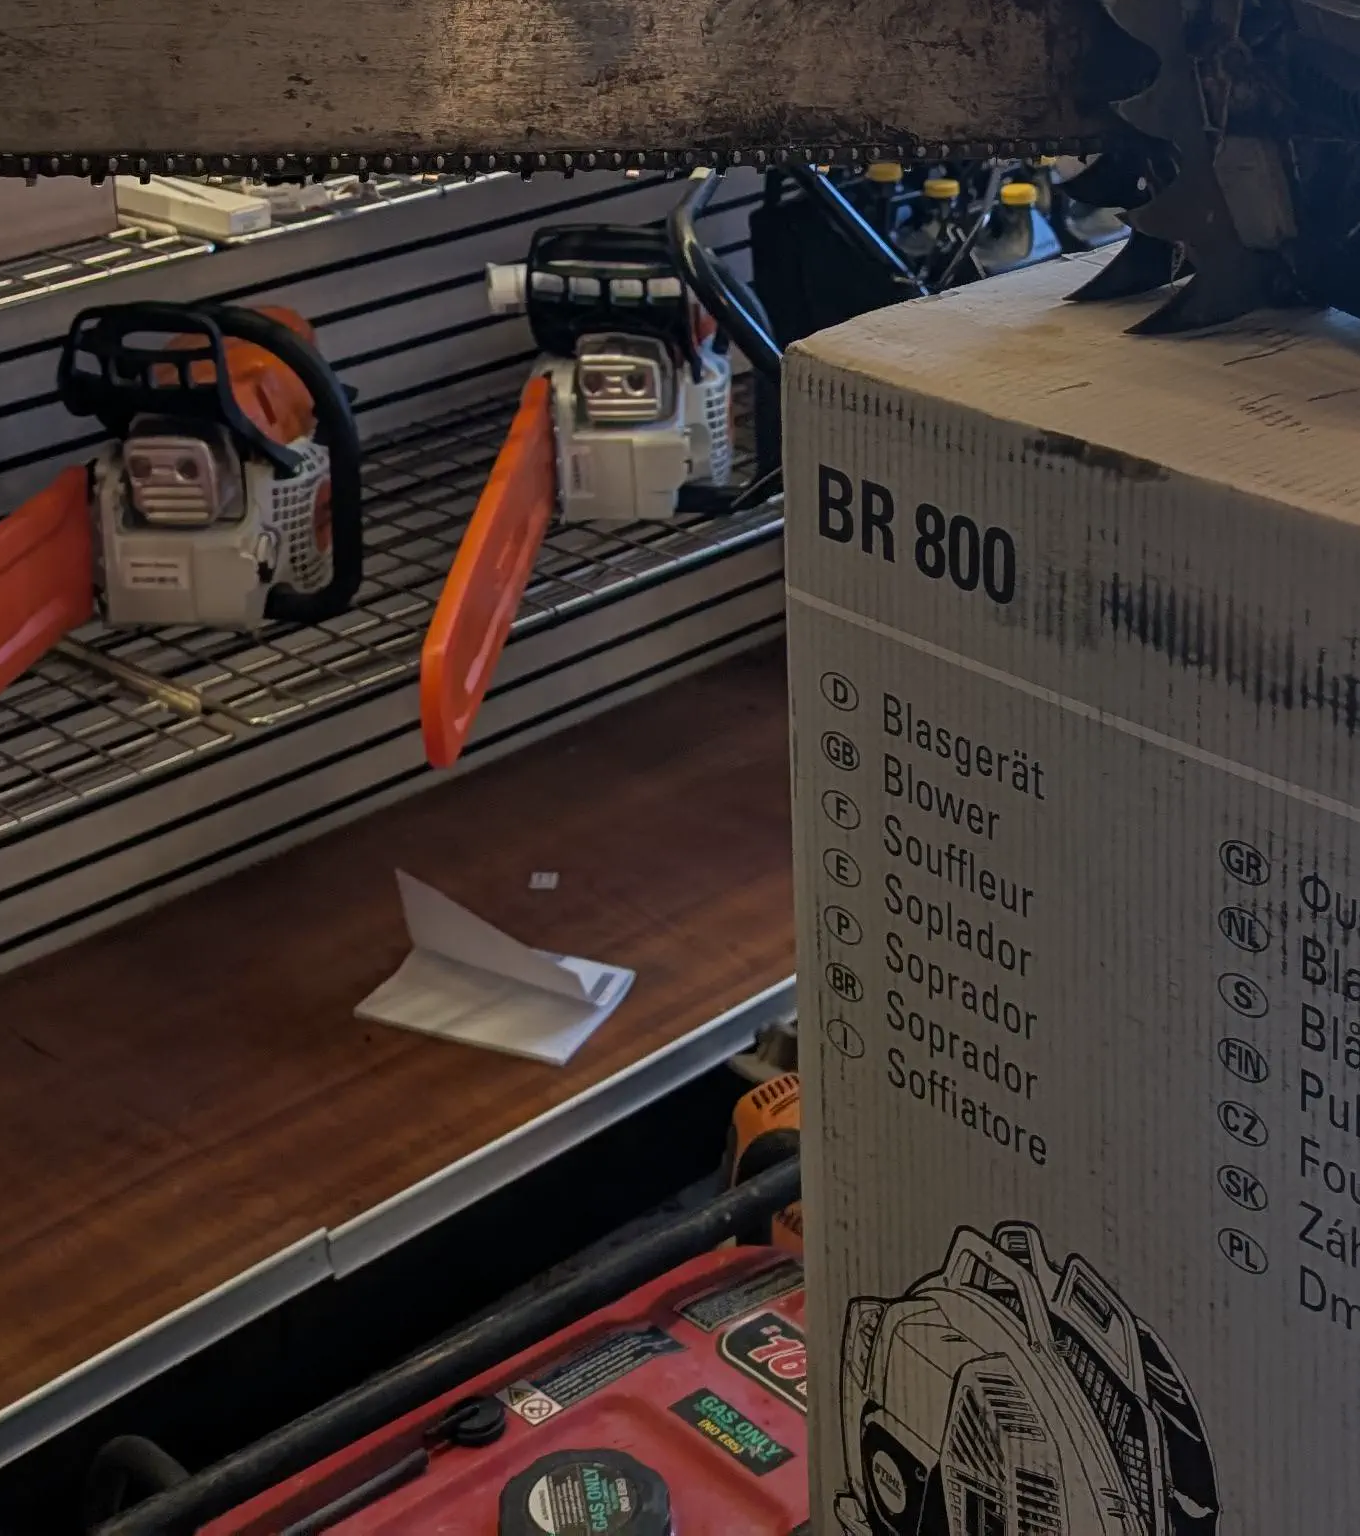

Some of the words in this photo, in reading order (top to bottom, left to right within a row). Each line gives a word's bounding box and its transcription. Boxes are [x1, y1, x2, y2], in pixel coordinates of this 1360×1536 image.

[818, 463, 896, 565] BR
[914, 502, 1017, 605] 800
[883, 692, 1046, 801] Blasgerät
[826, 735, 856, 766] GB
[883, 753, 1000, 841] Blower
[883, 814, 1034, 918] Souffleur
[1225, 845, 1262, 881] GR
[884, 873, 1033, 977] Soplador
[1226, 912, 1257, 949] NL
[885, 932, 1038, 1040] Soprador
[832, 969, 857, 999] BR
[886, 990, 1038, 1100] Soprador
[1223, 1042, 1262, 1081] FIN
[887, 1047, 1048, 1166] Soffiatore
[1223, 1108, 1260, 1144] CZ
[1225, 1170, 1260, 1206] SK
[1227, 1234, 1258, 1269] PL
[699, 1395, 740, 1425] GAS
[735, 1421, 783, 1457] ONLY
[582, 1468, 602, 1501] ONLY
[589, 1501, 609, 1532] GAS
